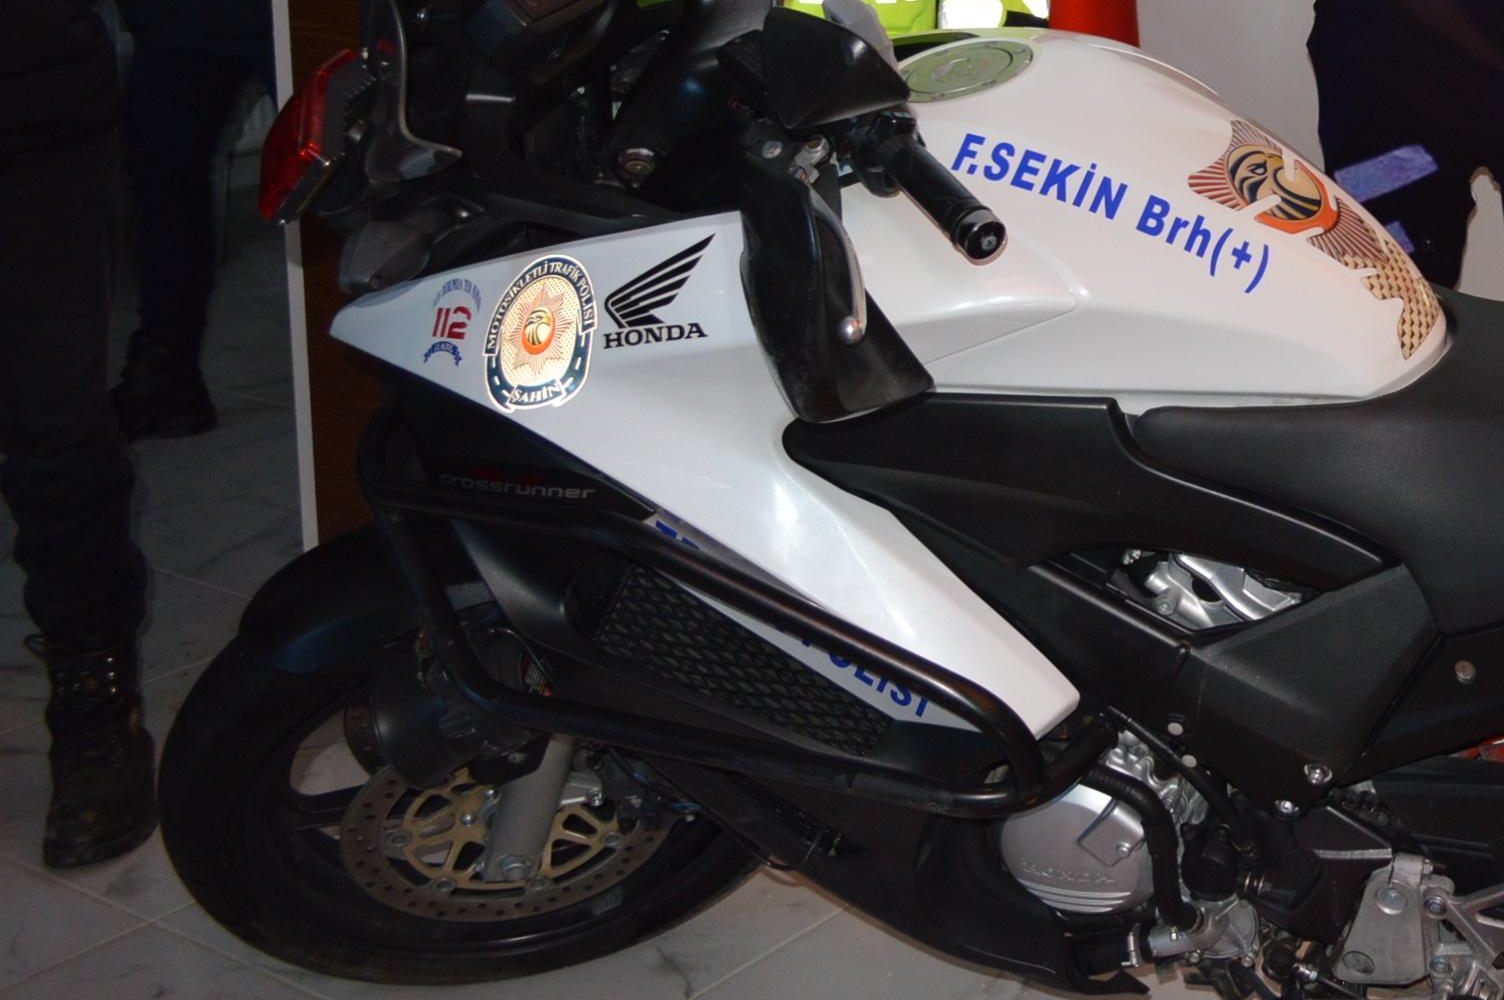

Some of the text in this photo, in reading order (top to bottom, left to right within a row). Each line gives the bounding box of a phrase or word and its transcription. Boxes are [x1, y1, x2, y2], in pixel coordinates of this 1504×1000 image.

[950, 132, 1270, 294] F.SEKİN Brh(+)
[550, 261, 583, 283] TRAFİK
[432, 306, 472, 340] 112
[603, 322, 709, 350] HONDA
[440, 474, 595, 499] crossrunner
